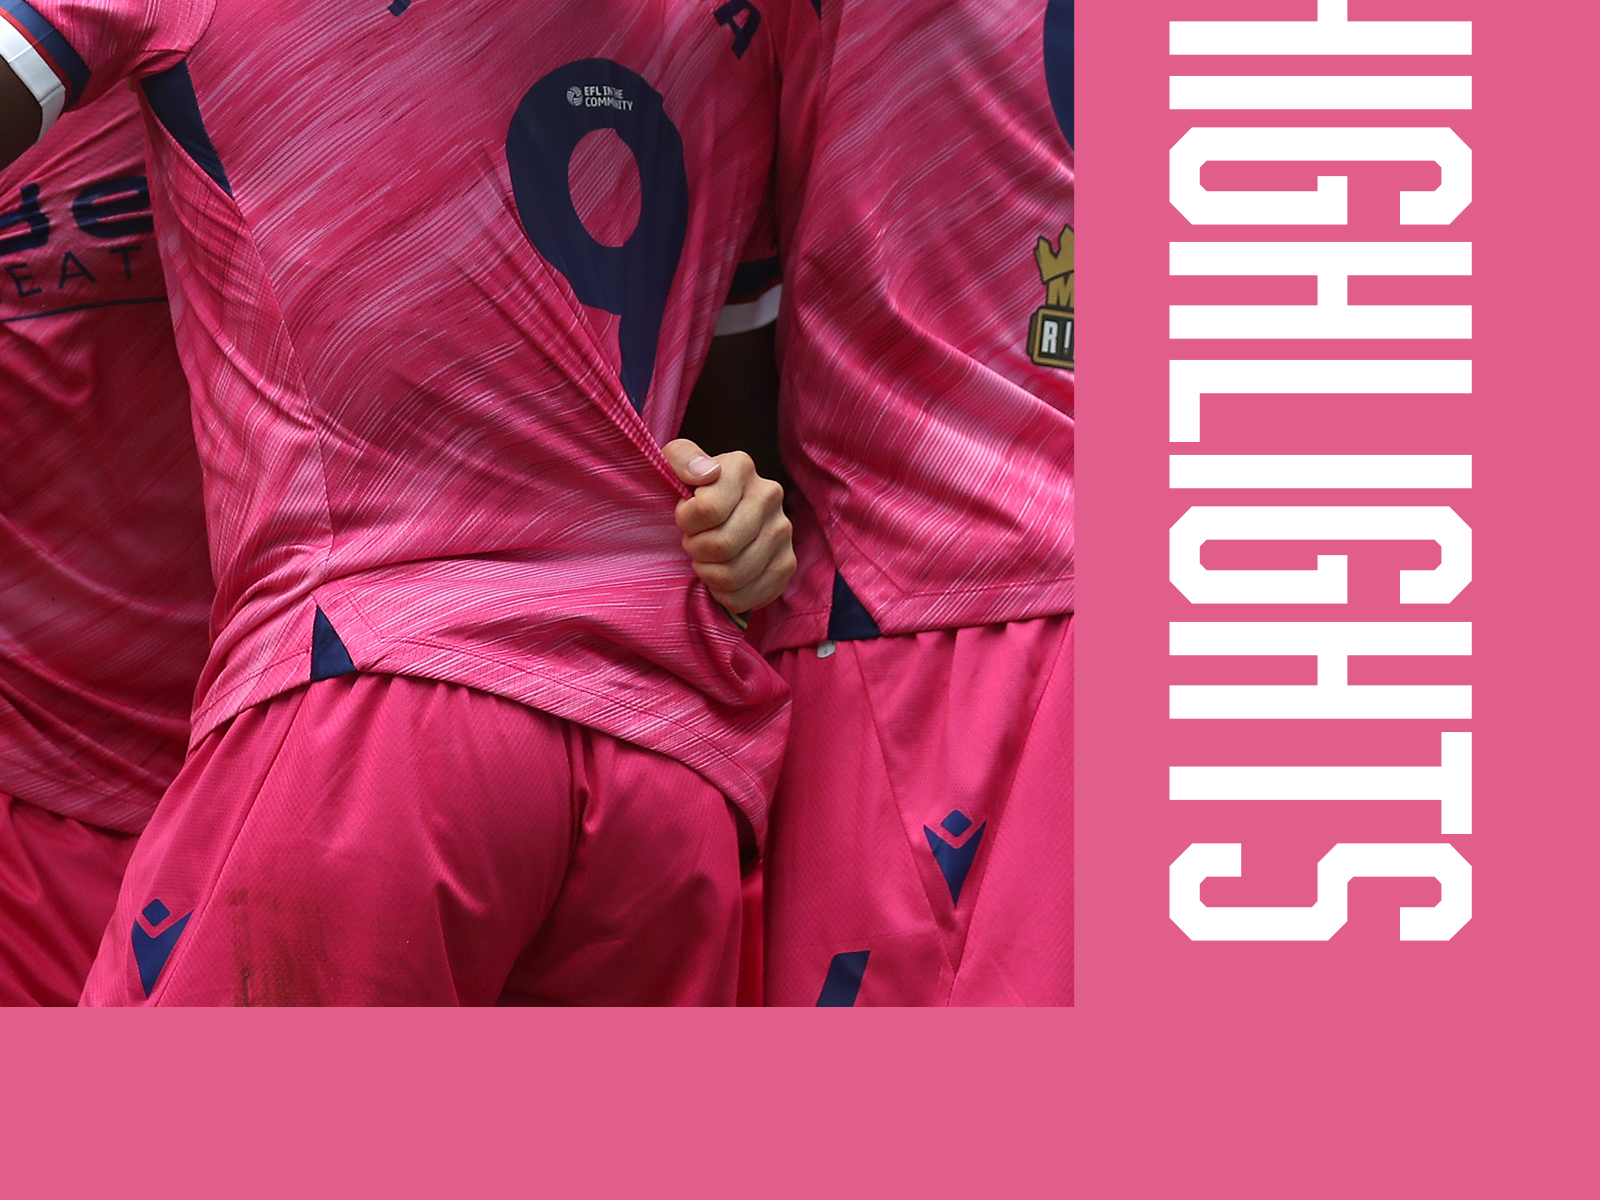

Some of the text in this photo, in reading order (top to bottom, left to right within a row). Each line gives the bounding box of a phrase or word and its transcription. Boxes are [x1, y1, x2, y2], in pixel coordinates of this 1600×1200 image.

[584, 86, 602, 96] EFL
[585, 96, 633, 111] COMMITY
[505, 57, 688, 416] 9
